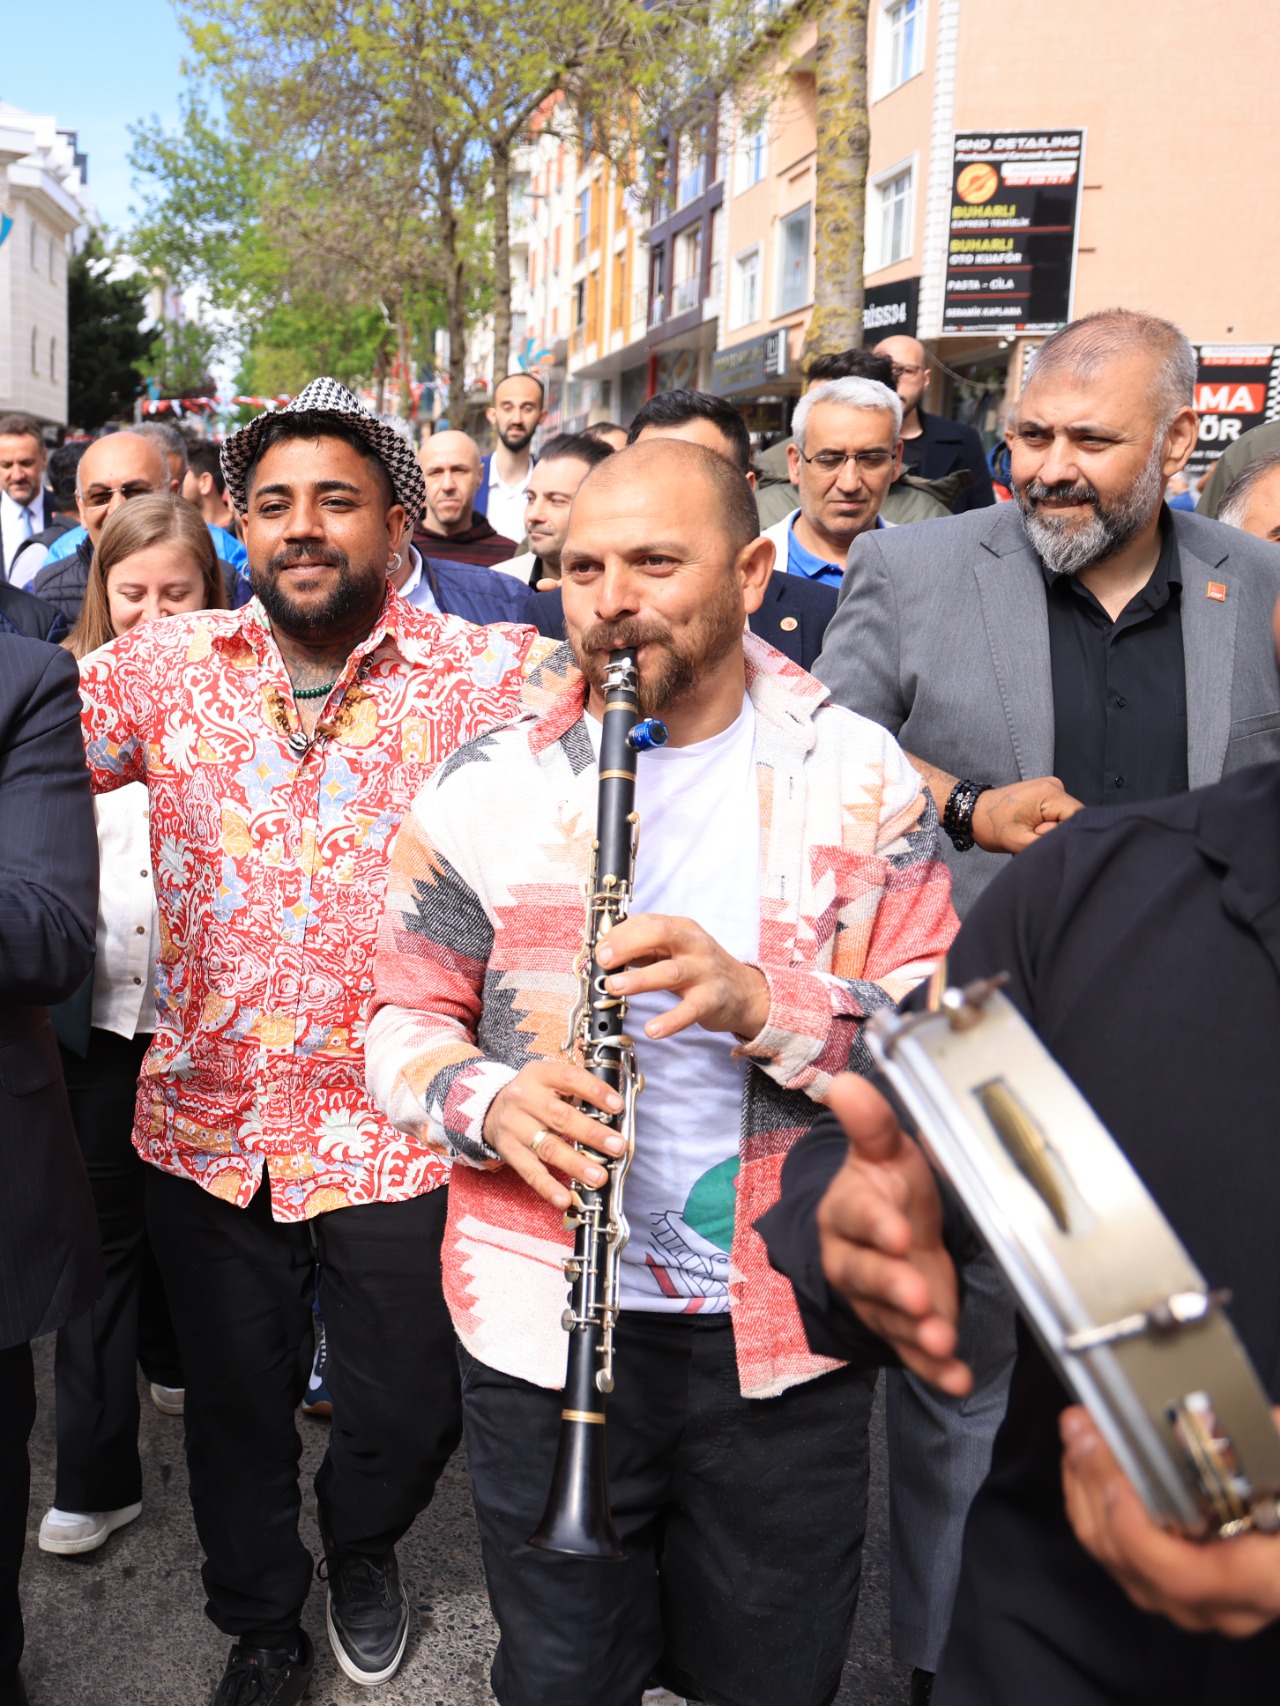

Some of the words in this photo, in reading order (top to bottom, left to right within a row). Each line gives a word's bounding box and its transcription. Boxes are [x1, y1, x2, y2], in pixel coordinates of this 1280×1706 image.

[949, 253, 974, 265] OTO
[974, 252, 1022, 264] KUAFÖR
[1198, 414, 1242, 441] ÖR
